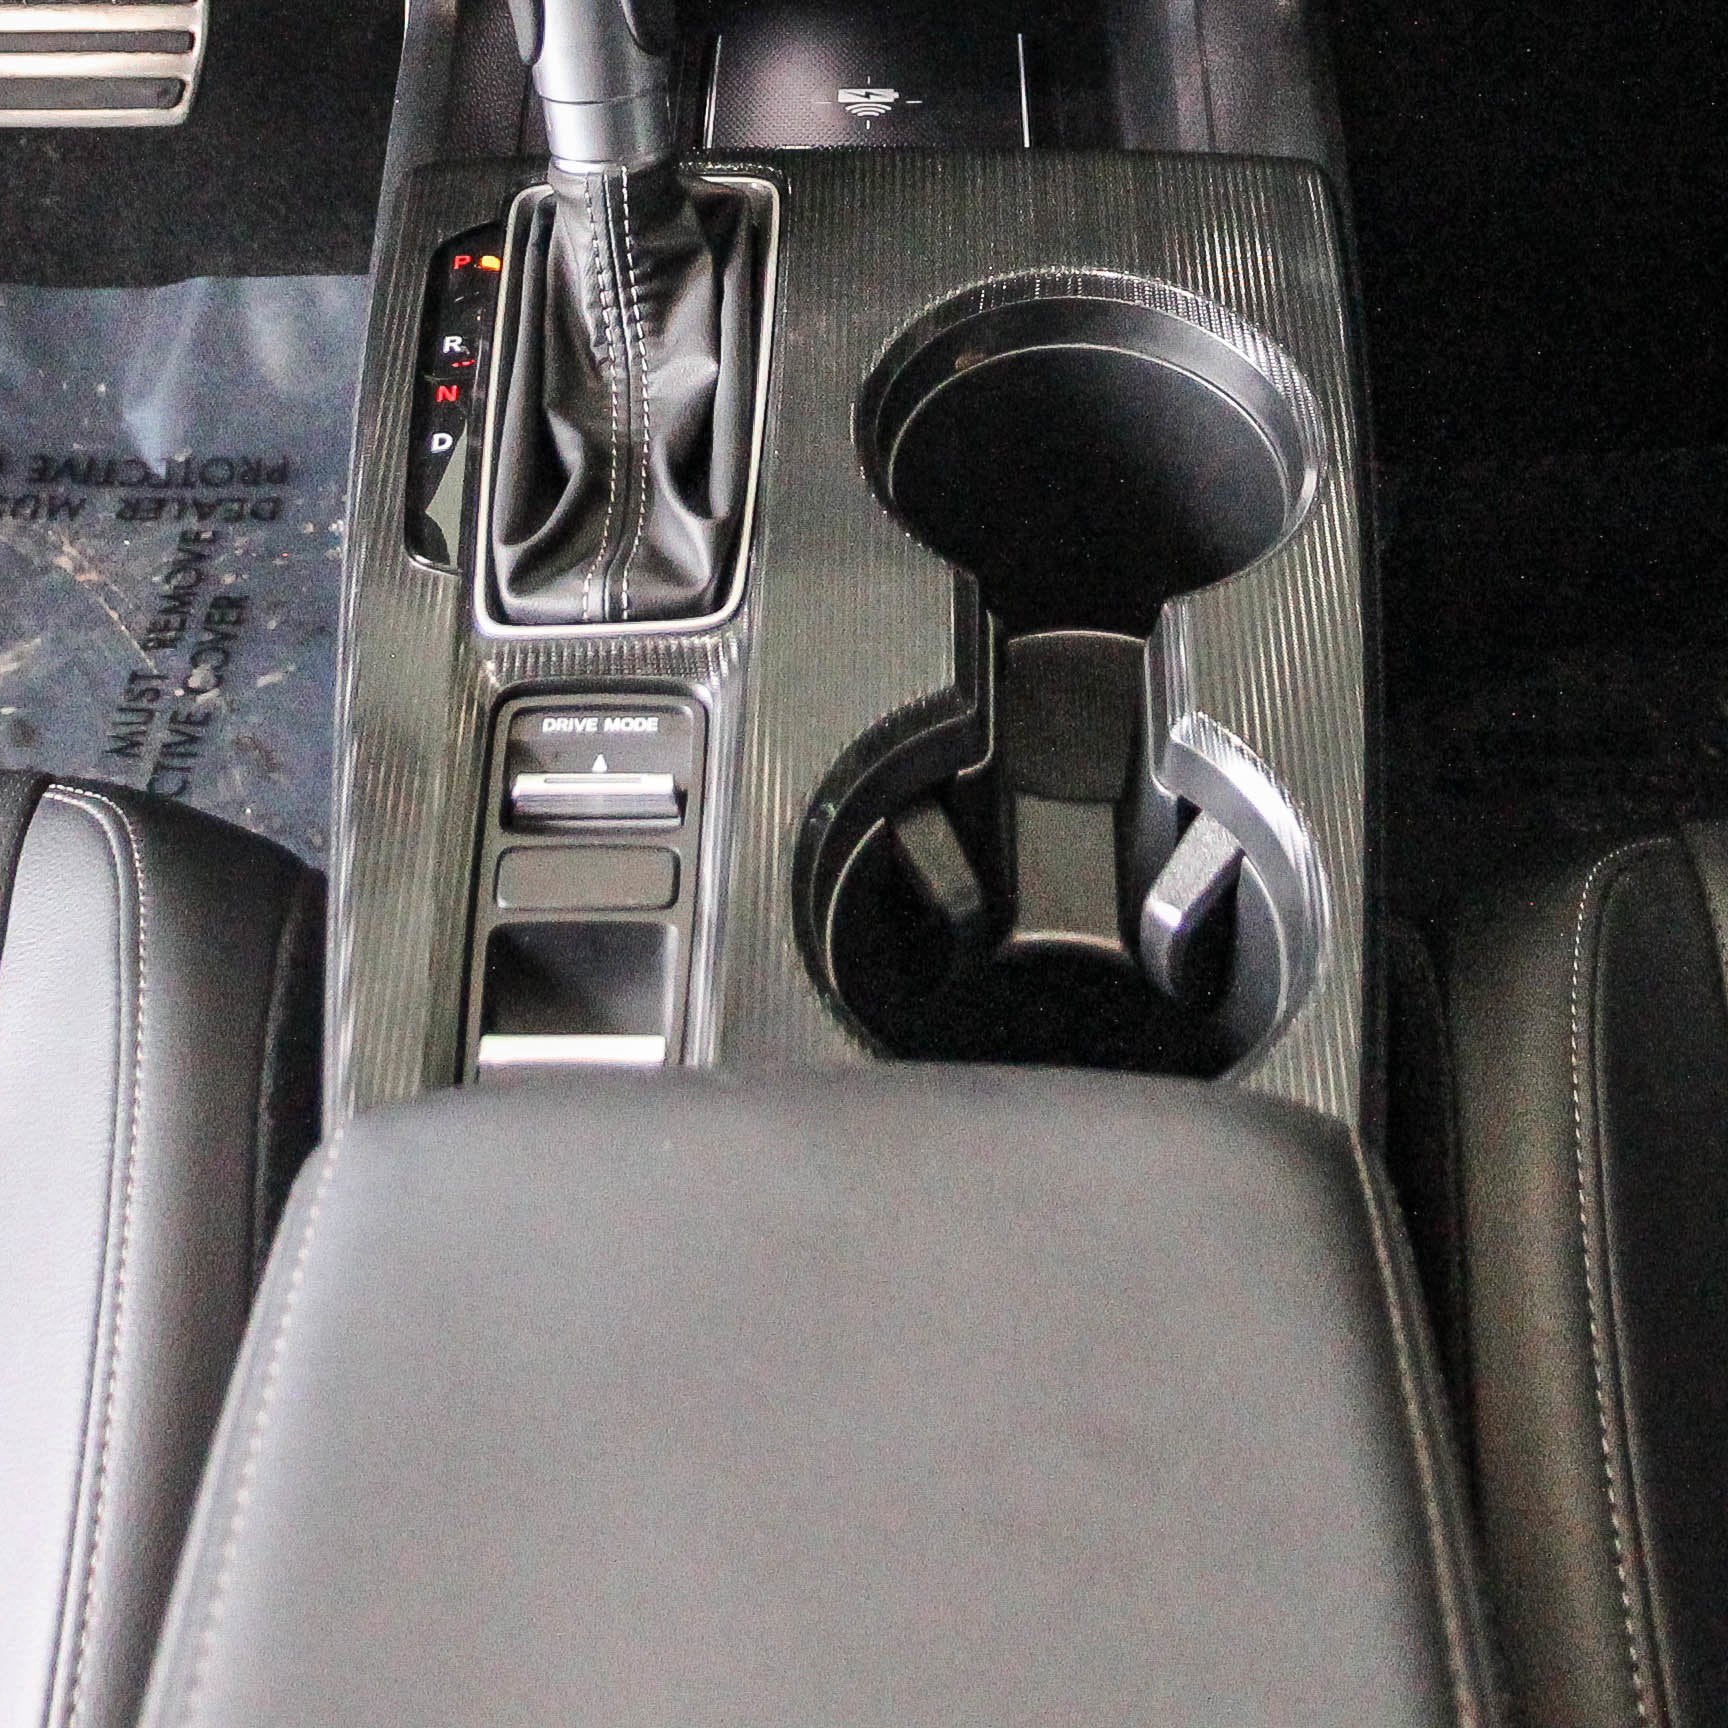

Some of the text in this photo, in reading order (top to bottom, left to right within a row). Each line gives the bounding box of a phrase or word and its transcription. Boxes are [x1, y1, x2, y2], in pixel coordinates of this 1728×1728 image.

[453, 255, 471, 270] P
[443, 335, 463, 353] R
[435, 384, 458, 402] N
[431, 432, 453, 452] D
[116, 495, 285, 522] DEALER
[105, 529, 215, 758] MUST REMOVE
[542, 716, 659, 733] DRIVE MODE
